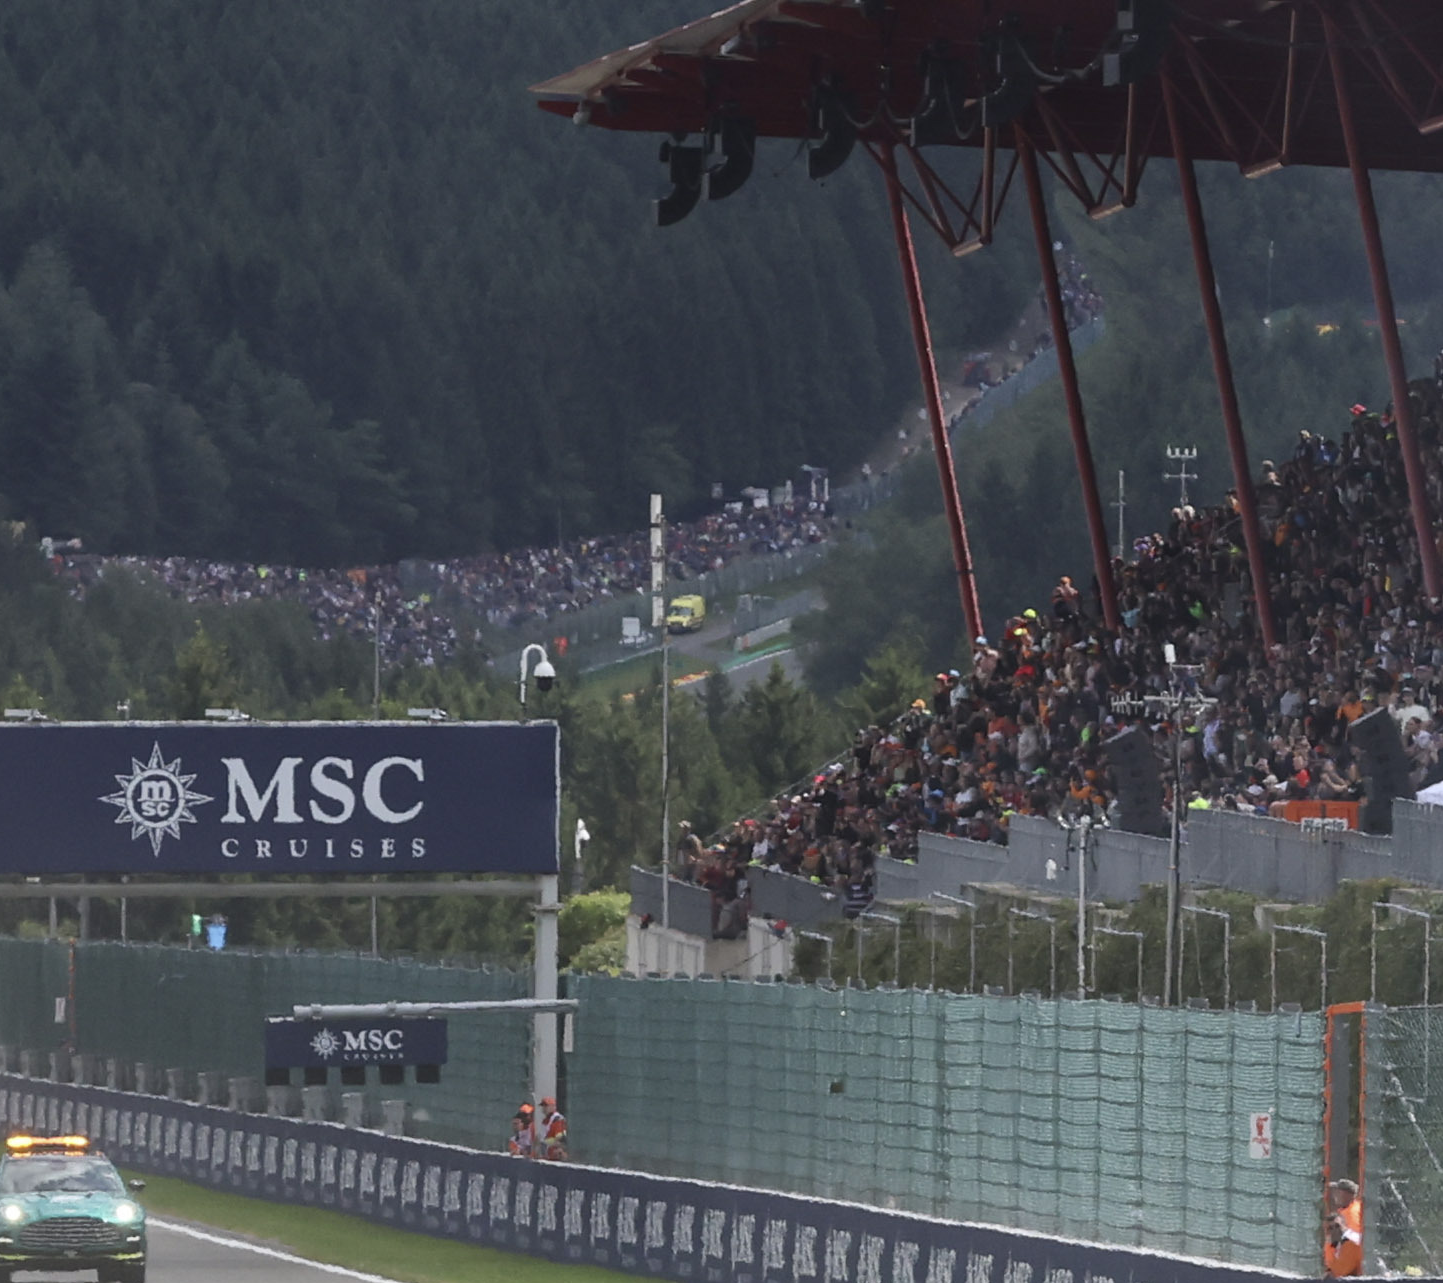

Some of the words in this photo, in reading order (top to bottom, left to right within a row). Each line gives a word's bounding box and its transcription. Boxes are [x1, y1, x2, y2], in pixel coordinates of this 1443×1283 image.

[221, 757, 424, 825] MSC
[221, 838, 426, 858] CRUISES
[342, 1030, 403, 1050] MSC
